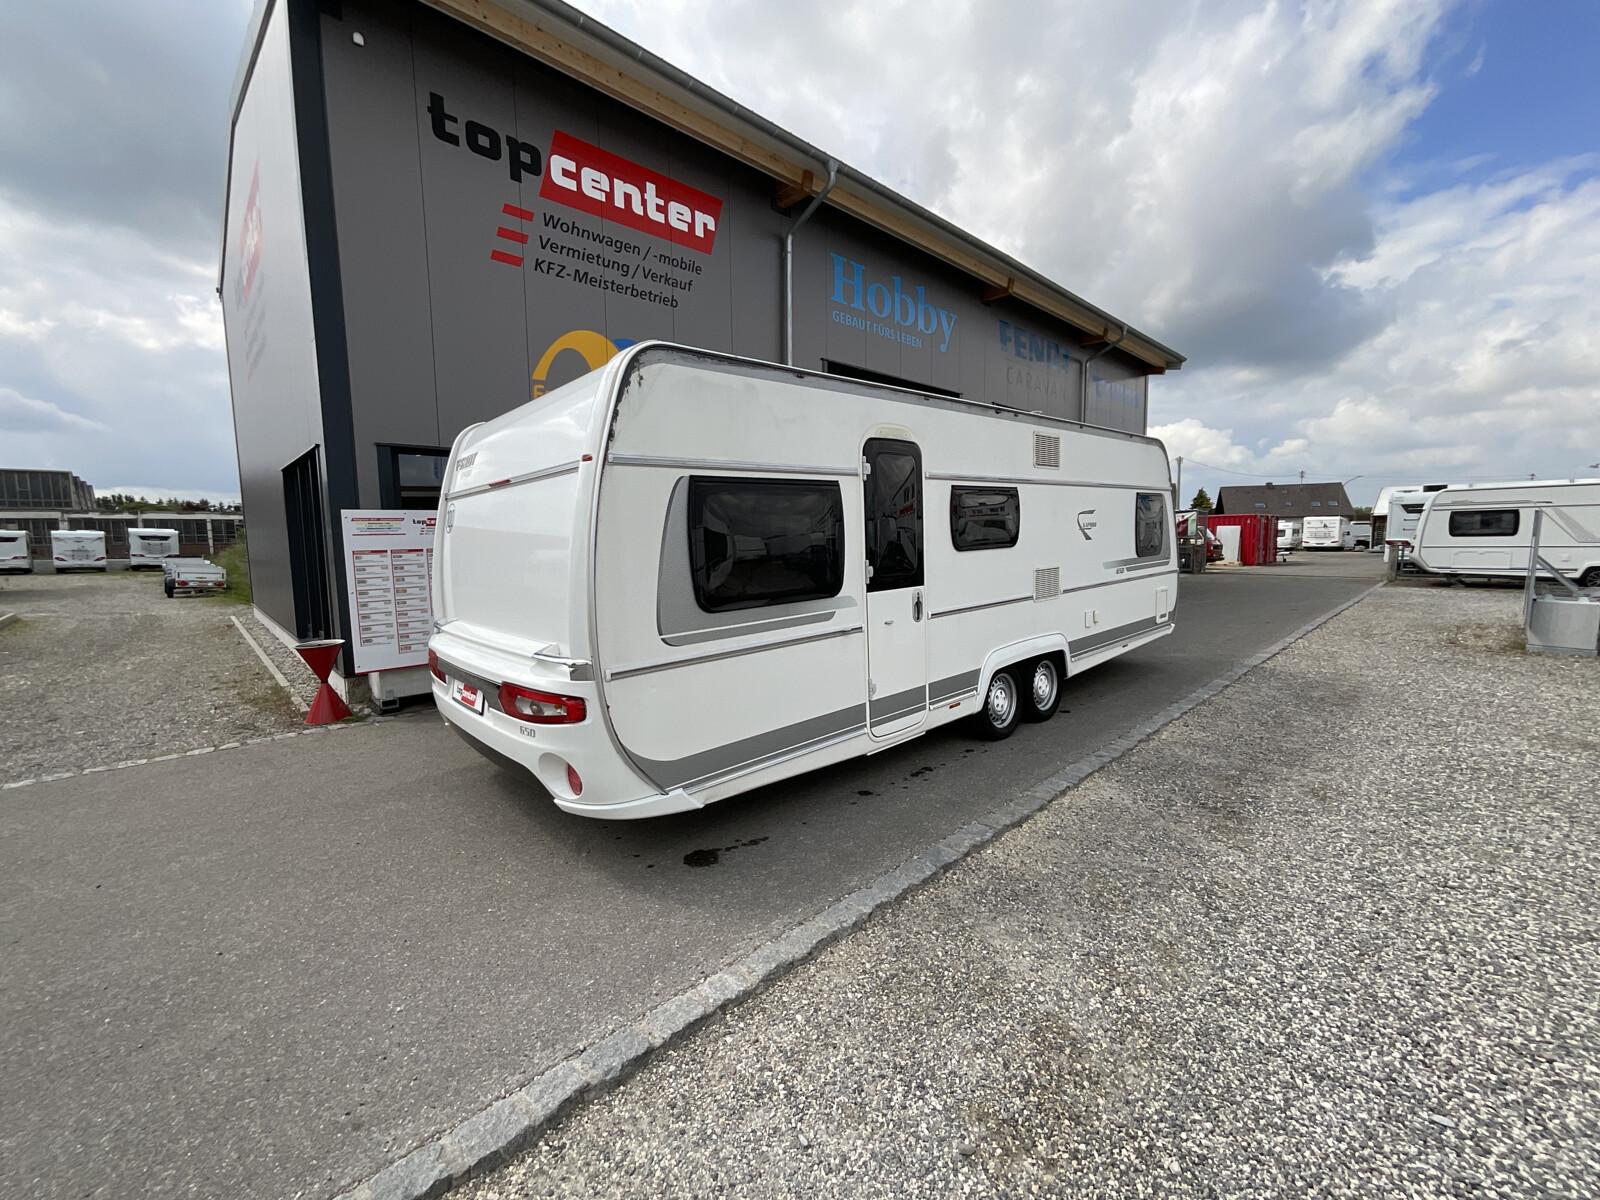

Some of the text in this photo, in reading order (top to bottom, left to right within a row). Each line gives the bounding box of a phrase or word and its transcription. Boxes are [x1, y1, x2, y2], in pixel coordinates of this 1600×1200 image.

[542, 212, 641, 256] Wohnwagen
[533, 257, 679, 309] KFZ-Meisterbetrieb
[538, 234, 631, 277] Vermietung
[642, 265, 694, 292] Verkauf
[830, 252, 958, 353] Hobby
[832, 310, 871, 333] GEBAUT
[896, 330, 923, 349] LEBEN
[519, 725, 536, 738] 650
